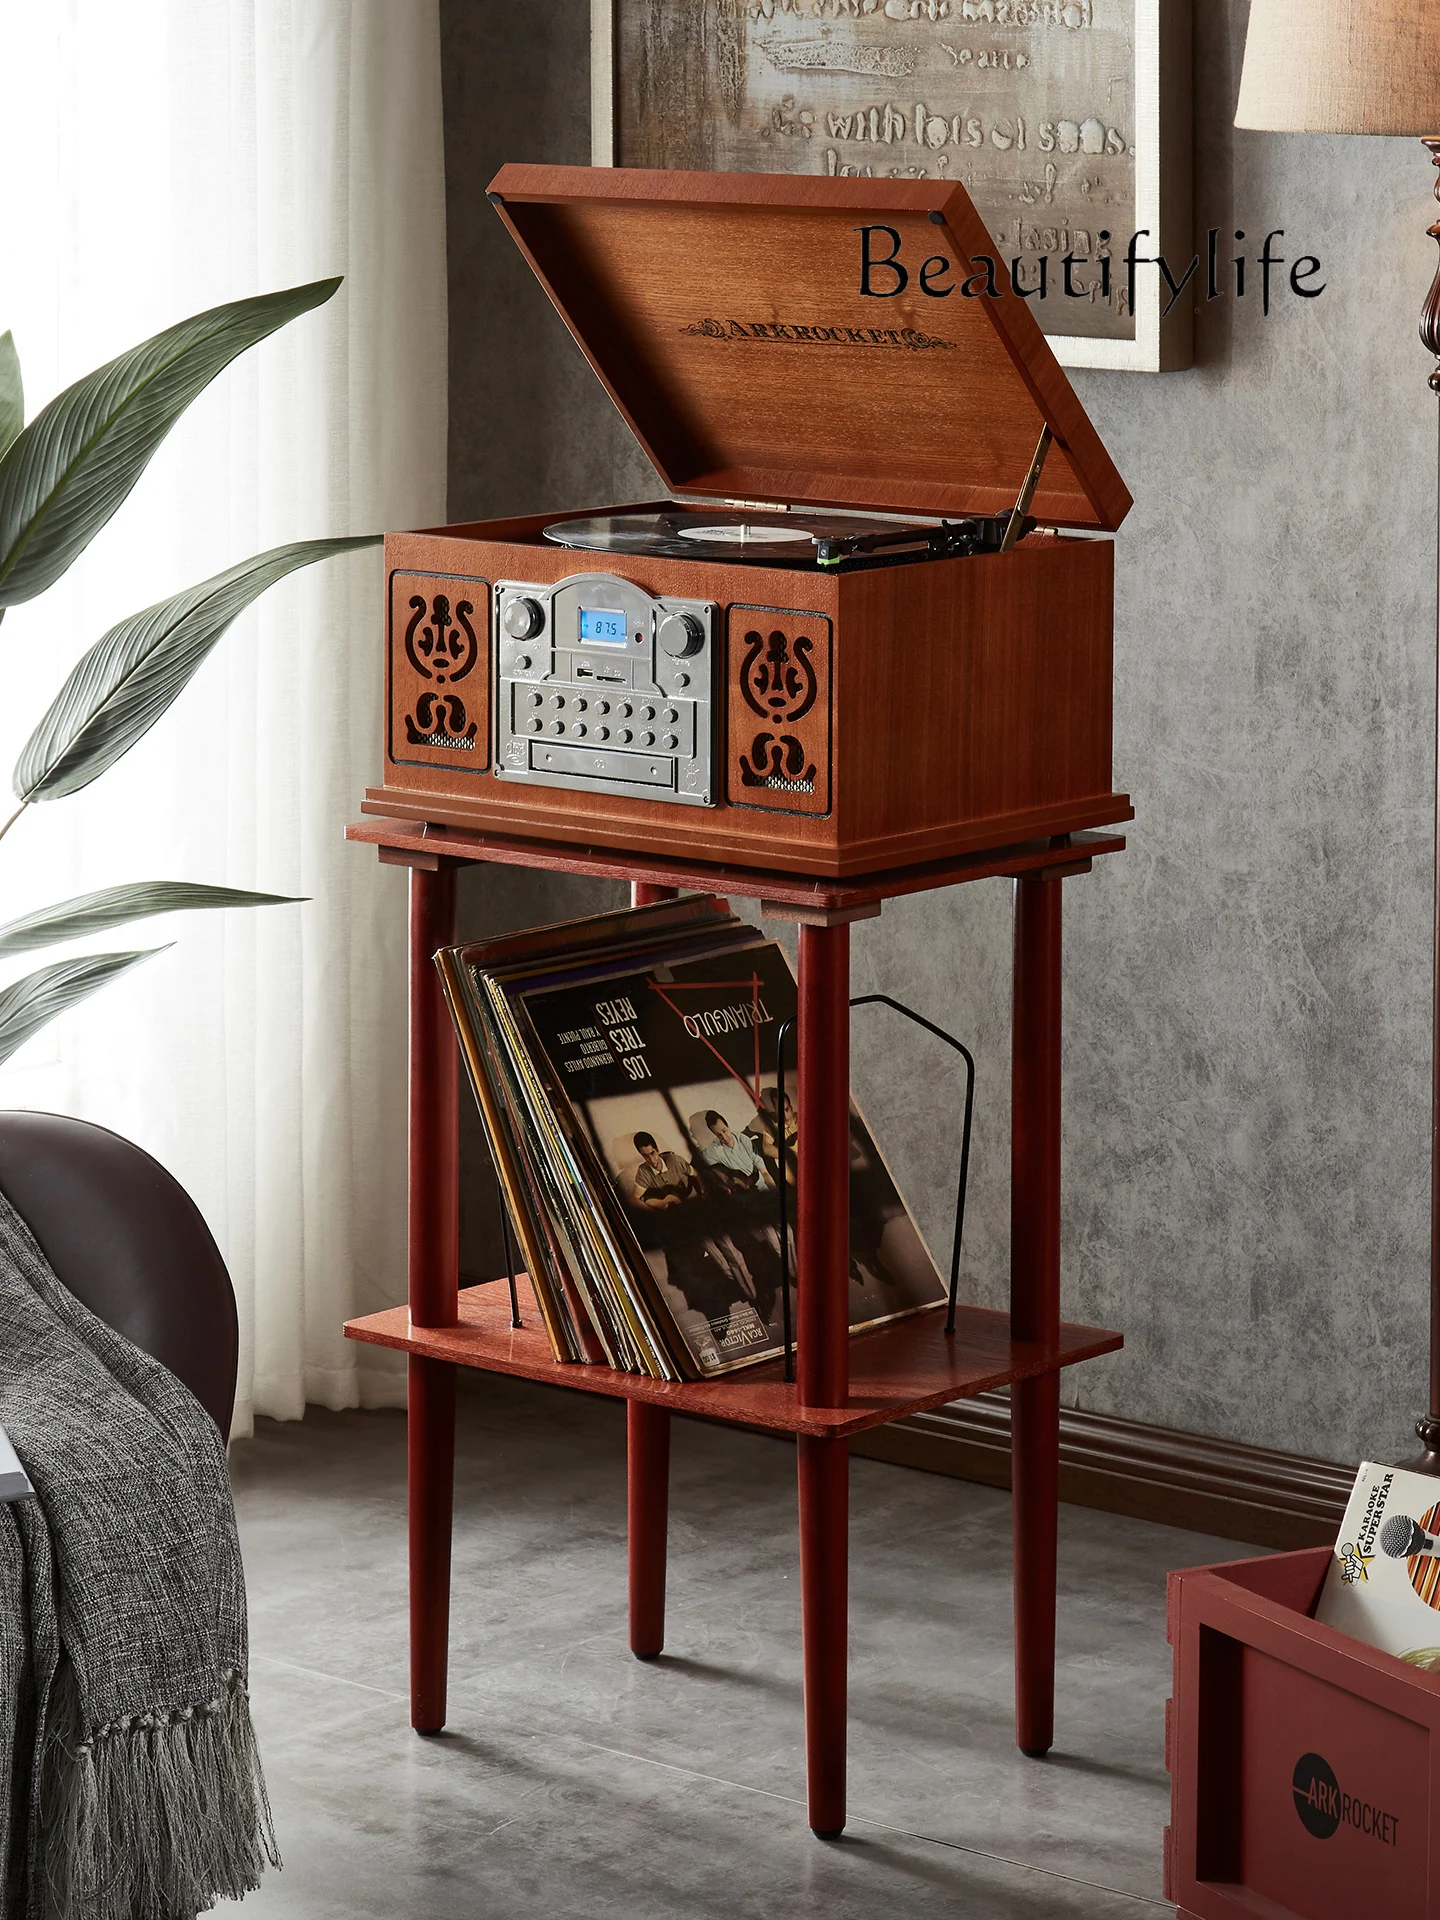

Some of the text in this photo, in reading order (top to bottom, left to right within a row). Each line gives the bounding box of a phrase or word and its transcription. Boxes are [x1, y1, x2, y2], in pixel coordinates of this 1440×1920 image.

[725, 318, 902, 345] ARKROCKET
[595, 621, 617, 636] 87.5
[595, 996, 638, 1025] REYES
[683, 998, 774, 1039] TRIANGULO
[579, 1039, 608, 1055] GILBERTO
[608, 1025, 647, 1053] TRES
[622, 1054, 652, 1081] LOS
[746, 1327, 764, 1340] RCA
[1358, 1485, 1380, 1541] KARAOKE
